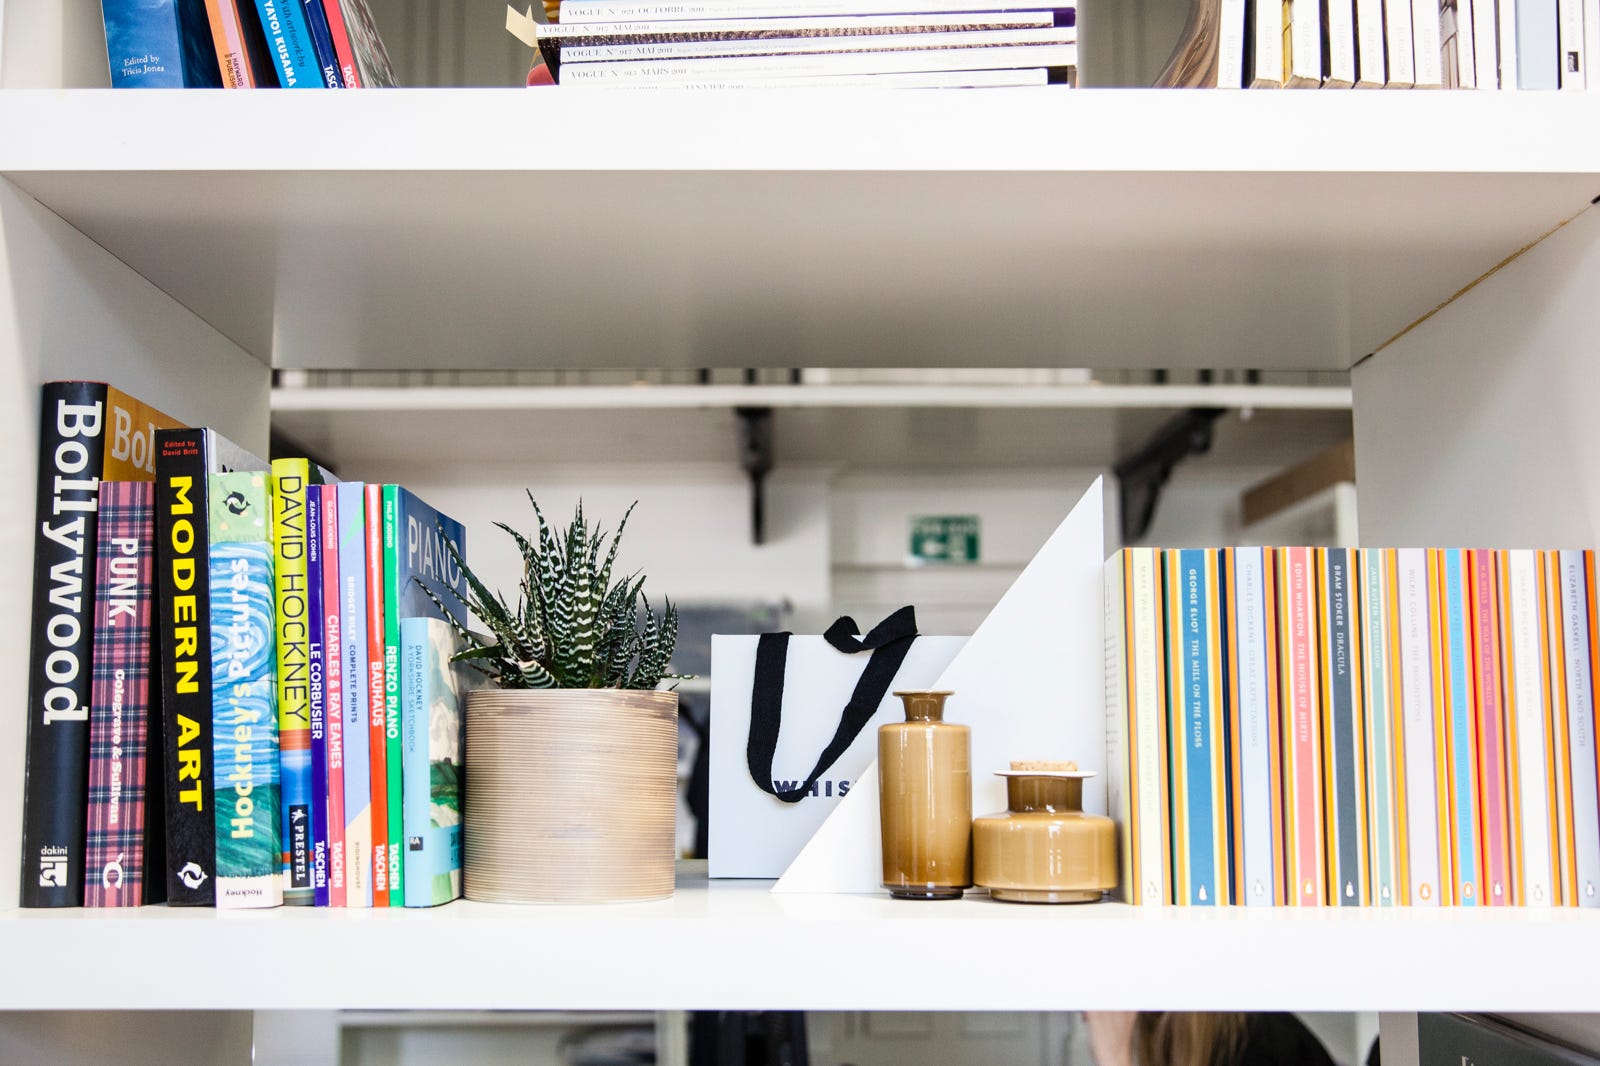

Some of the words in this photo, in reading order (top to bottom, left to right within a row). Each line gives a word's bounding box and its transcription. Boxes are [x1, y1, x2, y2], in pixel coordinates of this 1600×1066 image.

[542, 25, 577, 35] VOGUE
[614, 23, 633, 33] MAI
[567, 8, 602, 17] VOGUE
[638, 5, 685, 15] OCTOBRE
[124, 54, 149, 67] Edited
[150, 54, 160, 66] by
[264, 0, 283, 35] YAYOI
[274, 38, 297, 87] KUSAMA
[285, 19, 303, 54] artwork
[296, 55, 307, 68] by
[566, 49, 601, 58] VOGUE
[636, 46, 655, 56] MAI
[656, 45, 673, 55] 2011
[121, 67, 143, 77] Tricia
[143, 63, 165, 75] Jones
[232, 57, 244, 87] HAYWARD
[323, 64, 338, 88] TASC
[343, 63, 357, 88] TASC
[570, 70, 607, 80] VOGUE
[640, 67, 669, 78] MARS
[111, 404, 156, 474] Bol
[162, 449, 181, 457] David
[183, 448, 198, 456] Britt
[164, 440, 186, 448] Edited
[187, 440, 195, 448] by
[279, 475, 304, 560] DAVID
[309, 499, 317, 539] JEAN-LOUIS
[42, 399, 104, 725] Bollywood
[407, 513, 460, 590] PIANO
[108, 537, 139, 627] PUNK.
[170, 475, 199, 694] MODERN
[347, 575, 355, 614] BRIDGET
[1188, 567, 1197, 605] GEORGE
[1294, 562, 1302, 589] EDITH
[1333, 564, 1342, 589] BRAM
[1568, 563, 1577, 611] ELIZABETH
[228, 557, 251, 679] Pictures
[1190, 607, 1199, 633] ELIOT
[1295, 591, 1304, 637] WHARTON
[1335, 591, 1344, 626] STOKER
[281, 573, 308, 722] HOCKNEY
[309, 642, 321, 660] LE
[327, 614, 339, 677] CHARLES
[1191, 638, 1199, 657] THE
[1297, 642, 1305, 660] THE
[1571, 613, 1580, 651] GASKELL
[385, 645, 398, 692] RENZO
[1191, 659, 1200, 682] MILL
[1337, 631, 1346, 676] DRACULA
[329, 679, 339, 690] &
[371, 661, 384, 727] BAUHAUS
[415, 672, 423, 711] HOCKNEY
[1192, 683, 1201, 699] ON
[1298, 662, 1306, 694] HOUSE
[111, 667, 125, 745] Colegrave
[310, 662, 323, 740] CORBUSIER
[329, 692, 341, 719] RAY
[349, 692, 358, 723] PRINTS
[386, 695, 399, 740] PIANO
[1193, 700, 1202, 719] THE
[330, 722, 342, 769] EAMES
[408, 699, 416, 754] SKETCHBOOK
[1194, 720, 1203, 748] FLOSS
[1299, 710, 1308, 742] MIRTH
[177, 713, 203, 812] ART
[228, 682, 255, 840] Hockney's
[109, 760, 123, 825] Sullivan
[773, 780, 852, 797] WHIS
[40, 845, 68, 855] dakini
[294, 824, 306, 881] PRESTEL
[314, 840, 326, 888] TASCHEN
[332, 840, 344, 888] TASCHEN
[375, 843, 386, 891] TASCHEN
[389, 842, 400, 890] TASCHEN
